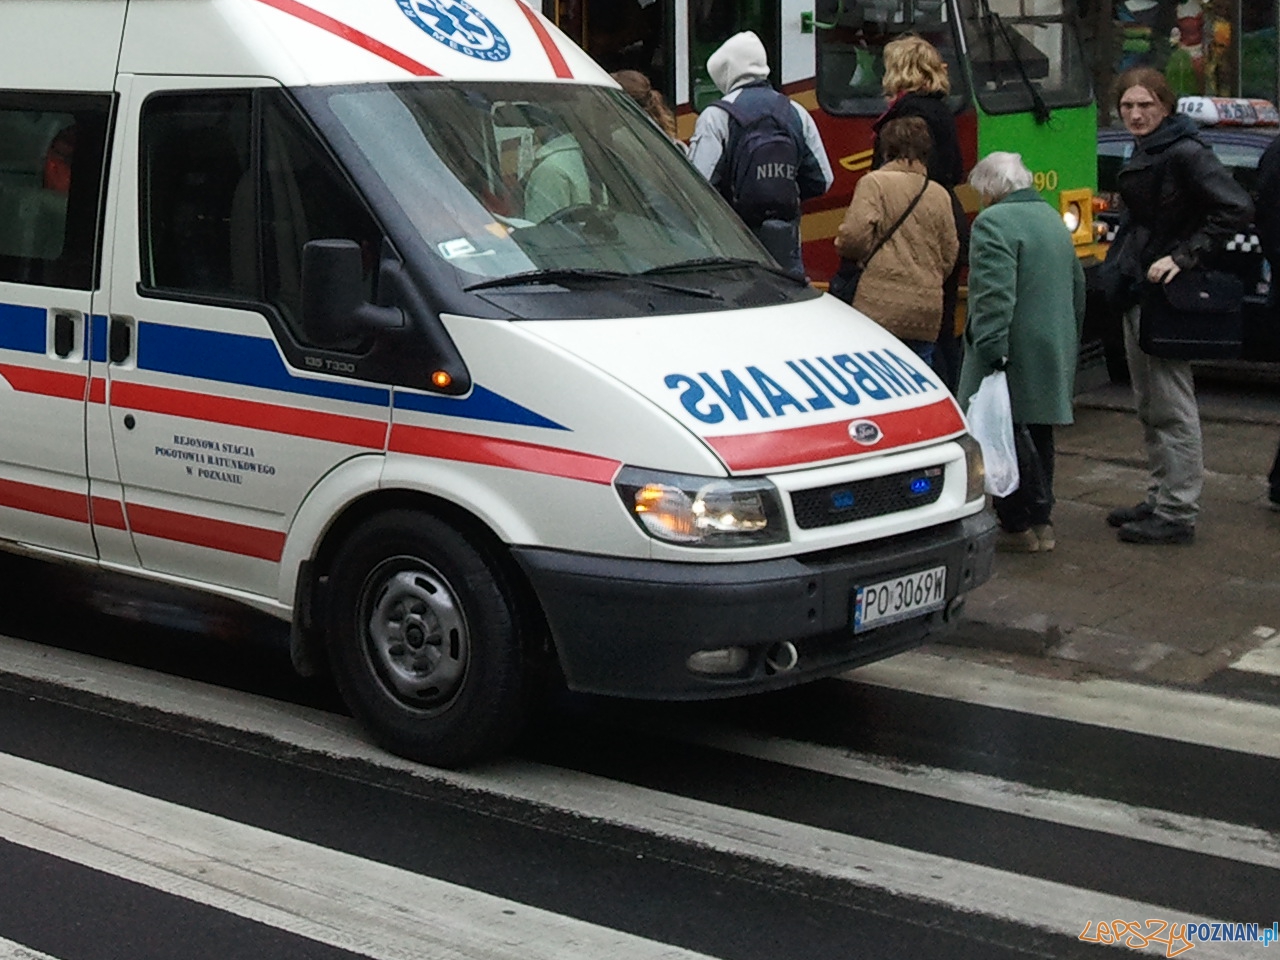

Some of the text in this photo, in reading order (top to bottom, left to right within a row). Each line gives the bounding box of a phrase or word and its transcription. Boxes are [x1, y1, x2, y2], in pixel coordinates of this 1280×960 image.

[757, 162, 795, 180] NIKE
[174, 435, 255, 457] REJONOWA STACJA
[155, 446, 276, 475] POGOTOWIA RATUNKOWEGO
[186, 466, 243, 484] W POZNANIU
[864, 584, 889, 620] PO
